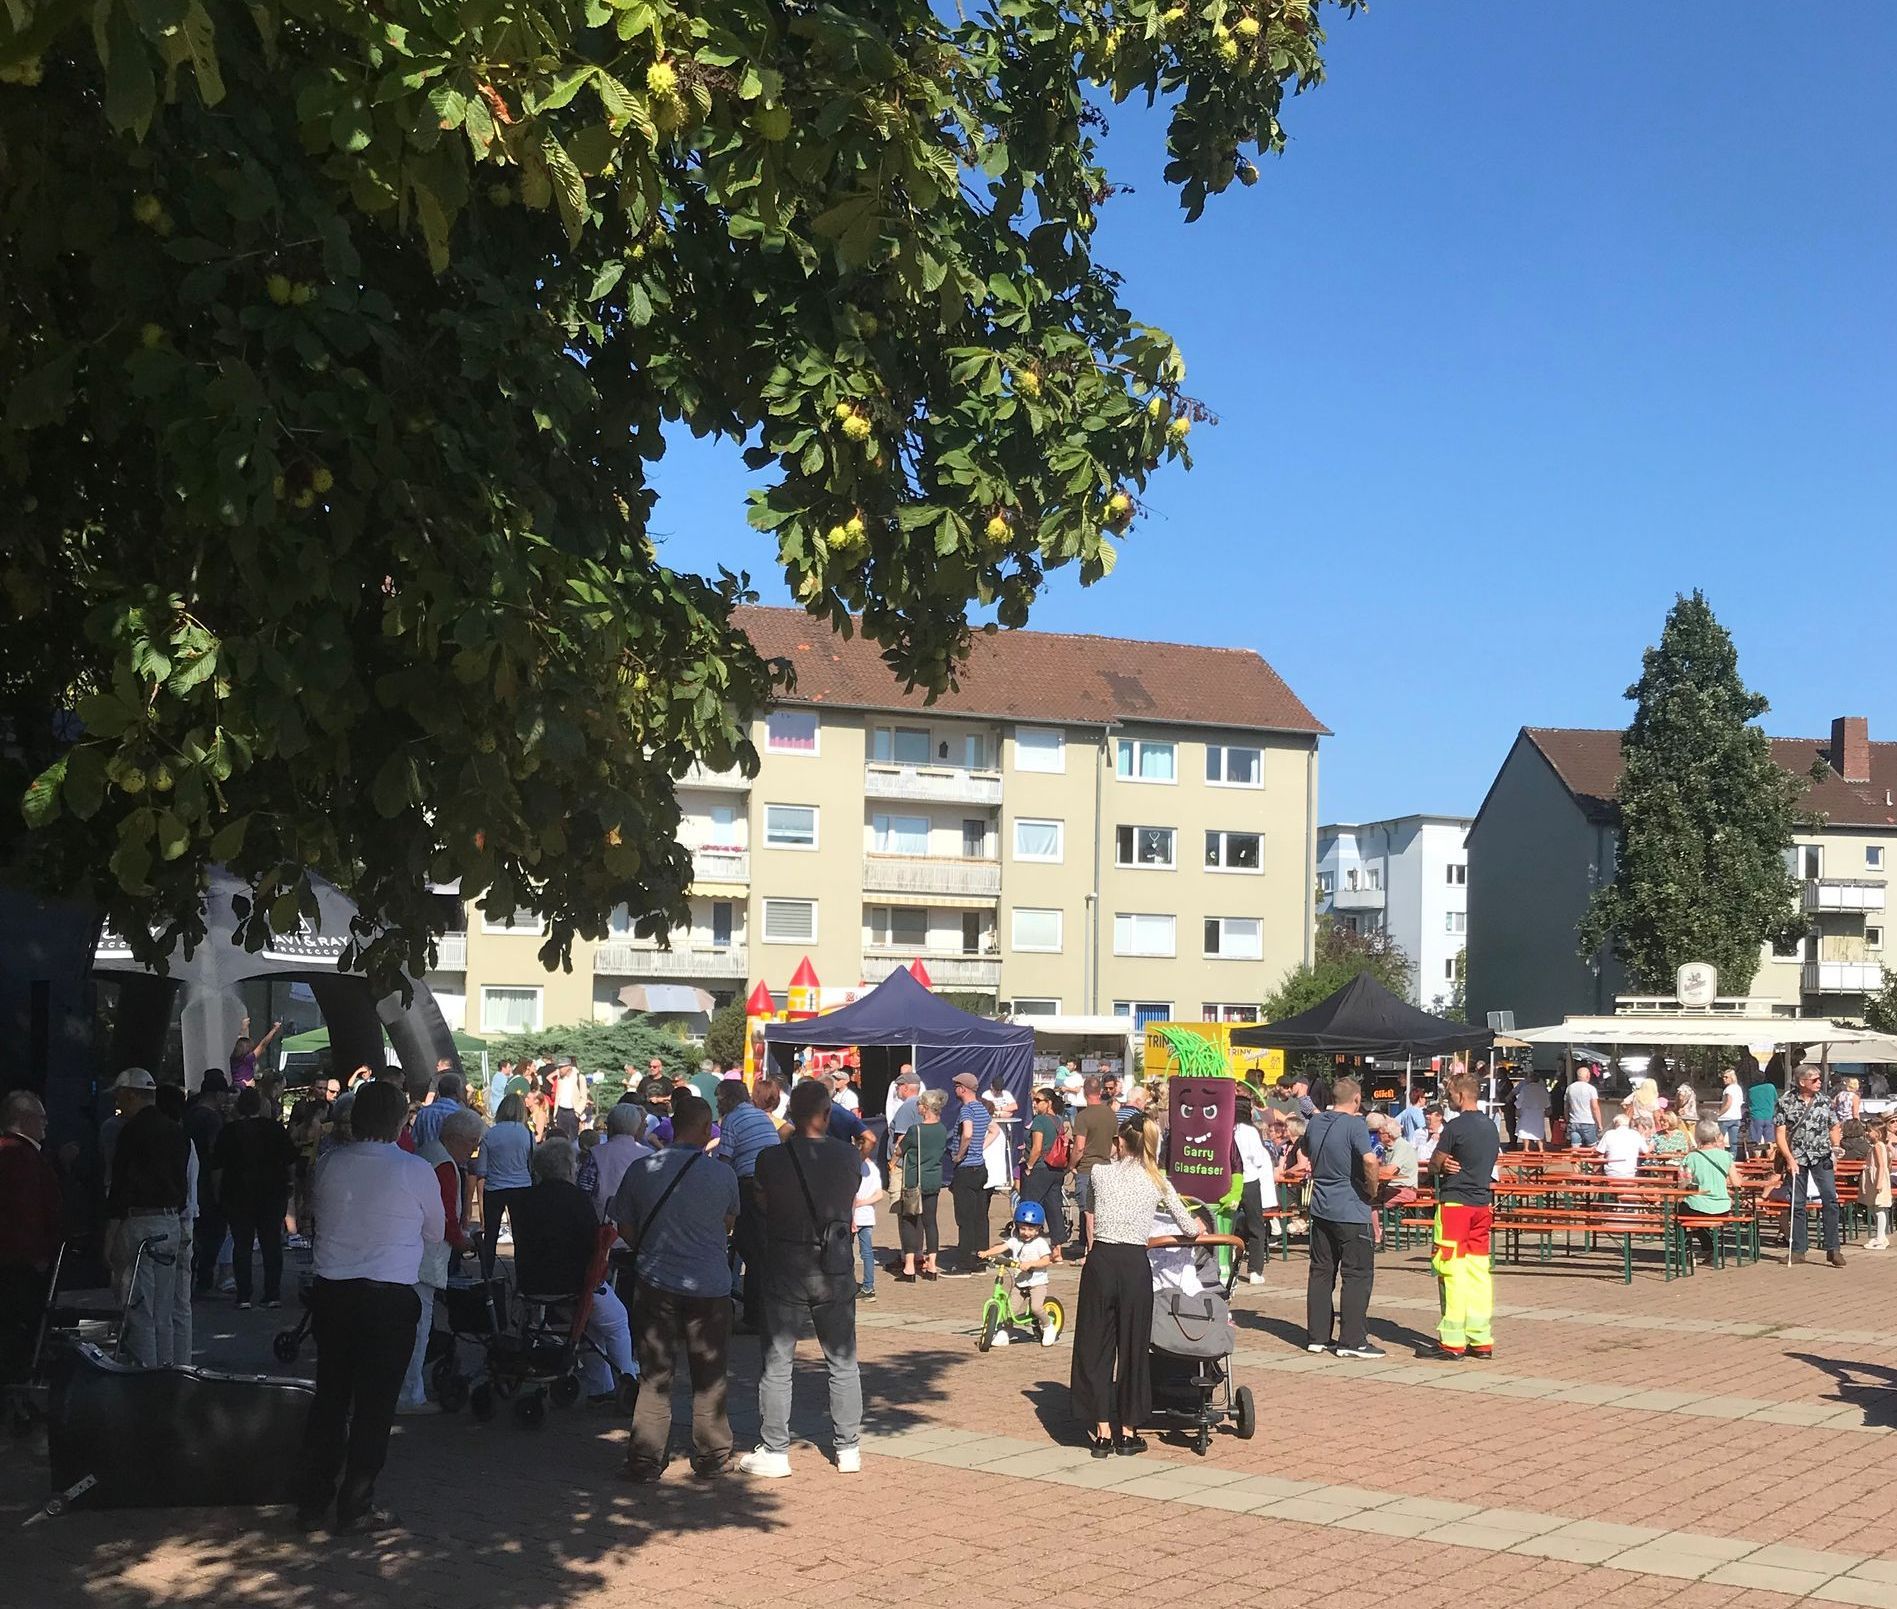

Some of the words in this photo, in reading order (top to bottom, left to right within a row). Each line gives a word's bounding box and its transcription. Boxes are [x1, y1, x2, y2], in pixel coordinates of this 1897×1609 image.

[1147, 1034, 1170, 1048] TRIN
[1183, 1145, 1214, 1161] Garry
[1174, 1161, 1224, 1175] Glasfaser
